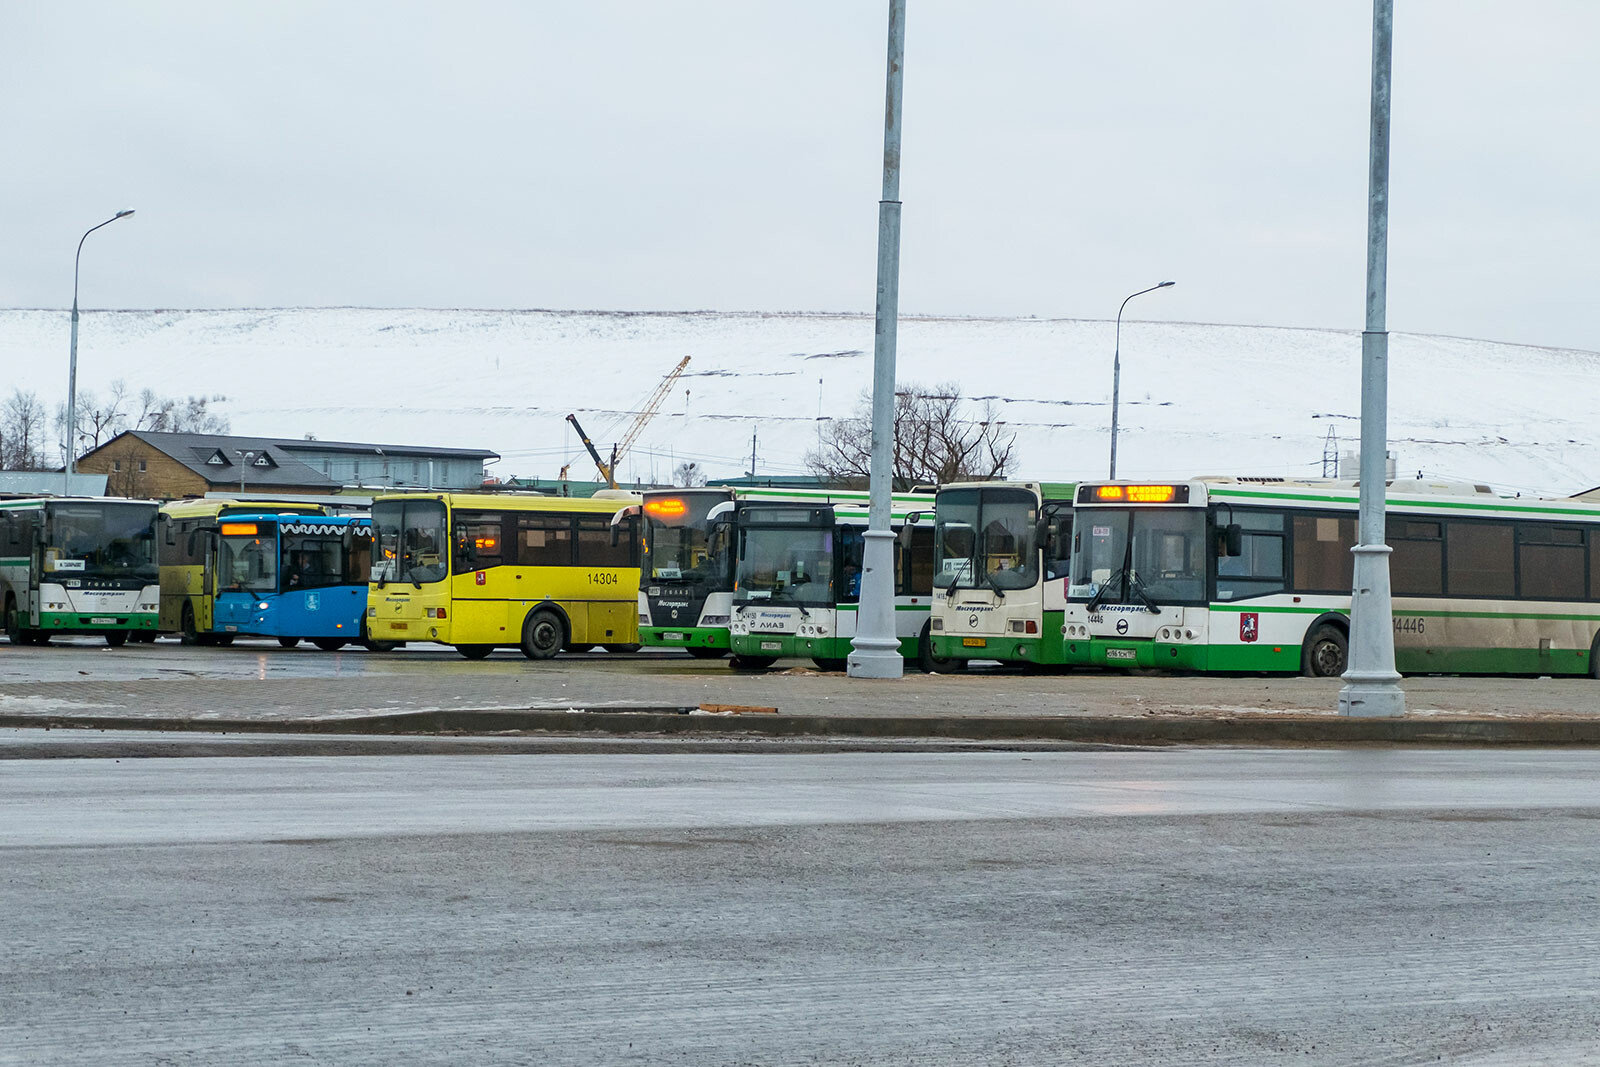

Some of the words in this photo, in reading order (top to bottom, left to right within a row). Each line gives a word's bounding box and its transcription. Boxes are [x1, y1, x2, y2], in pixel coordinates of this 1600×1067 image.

[588, 573, 617, 584] 14304
[1099, 604, 1147, 613] Мосгортранс
[1392, 618, 1424, 633] 14446
